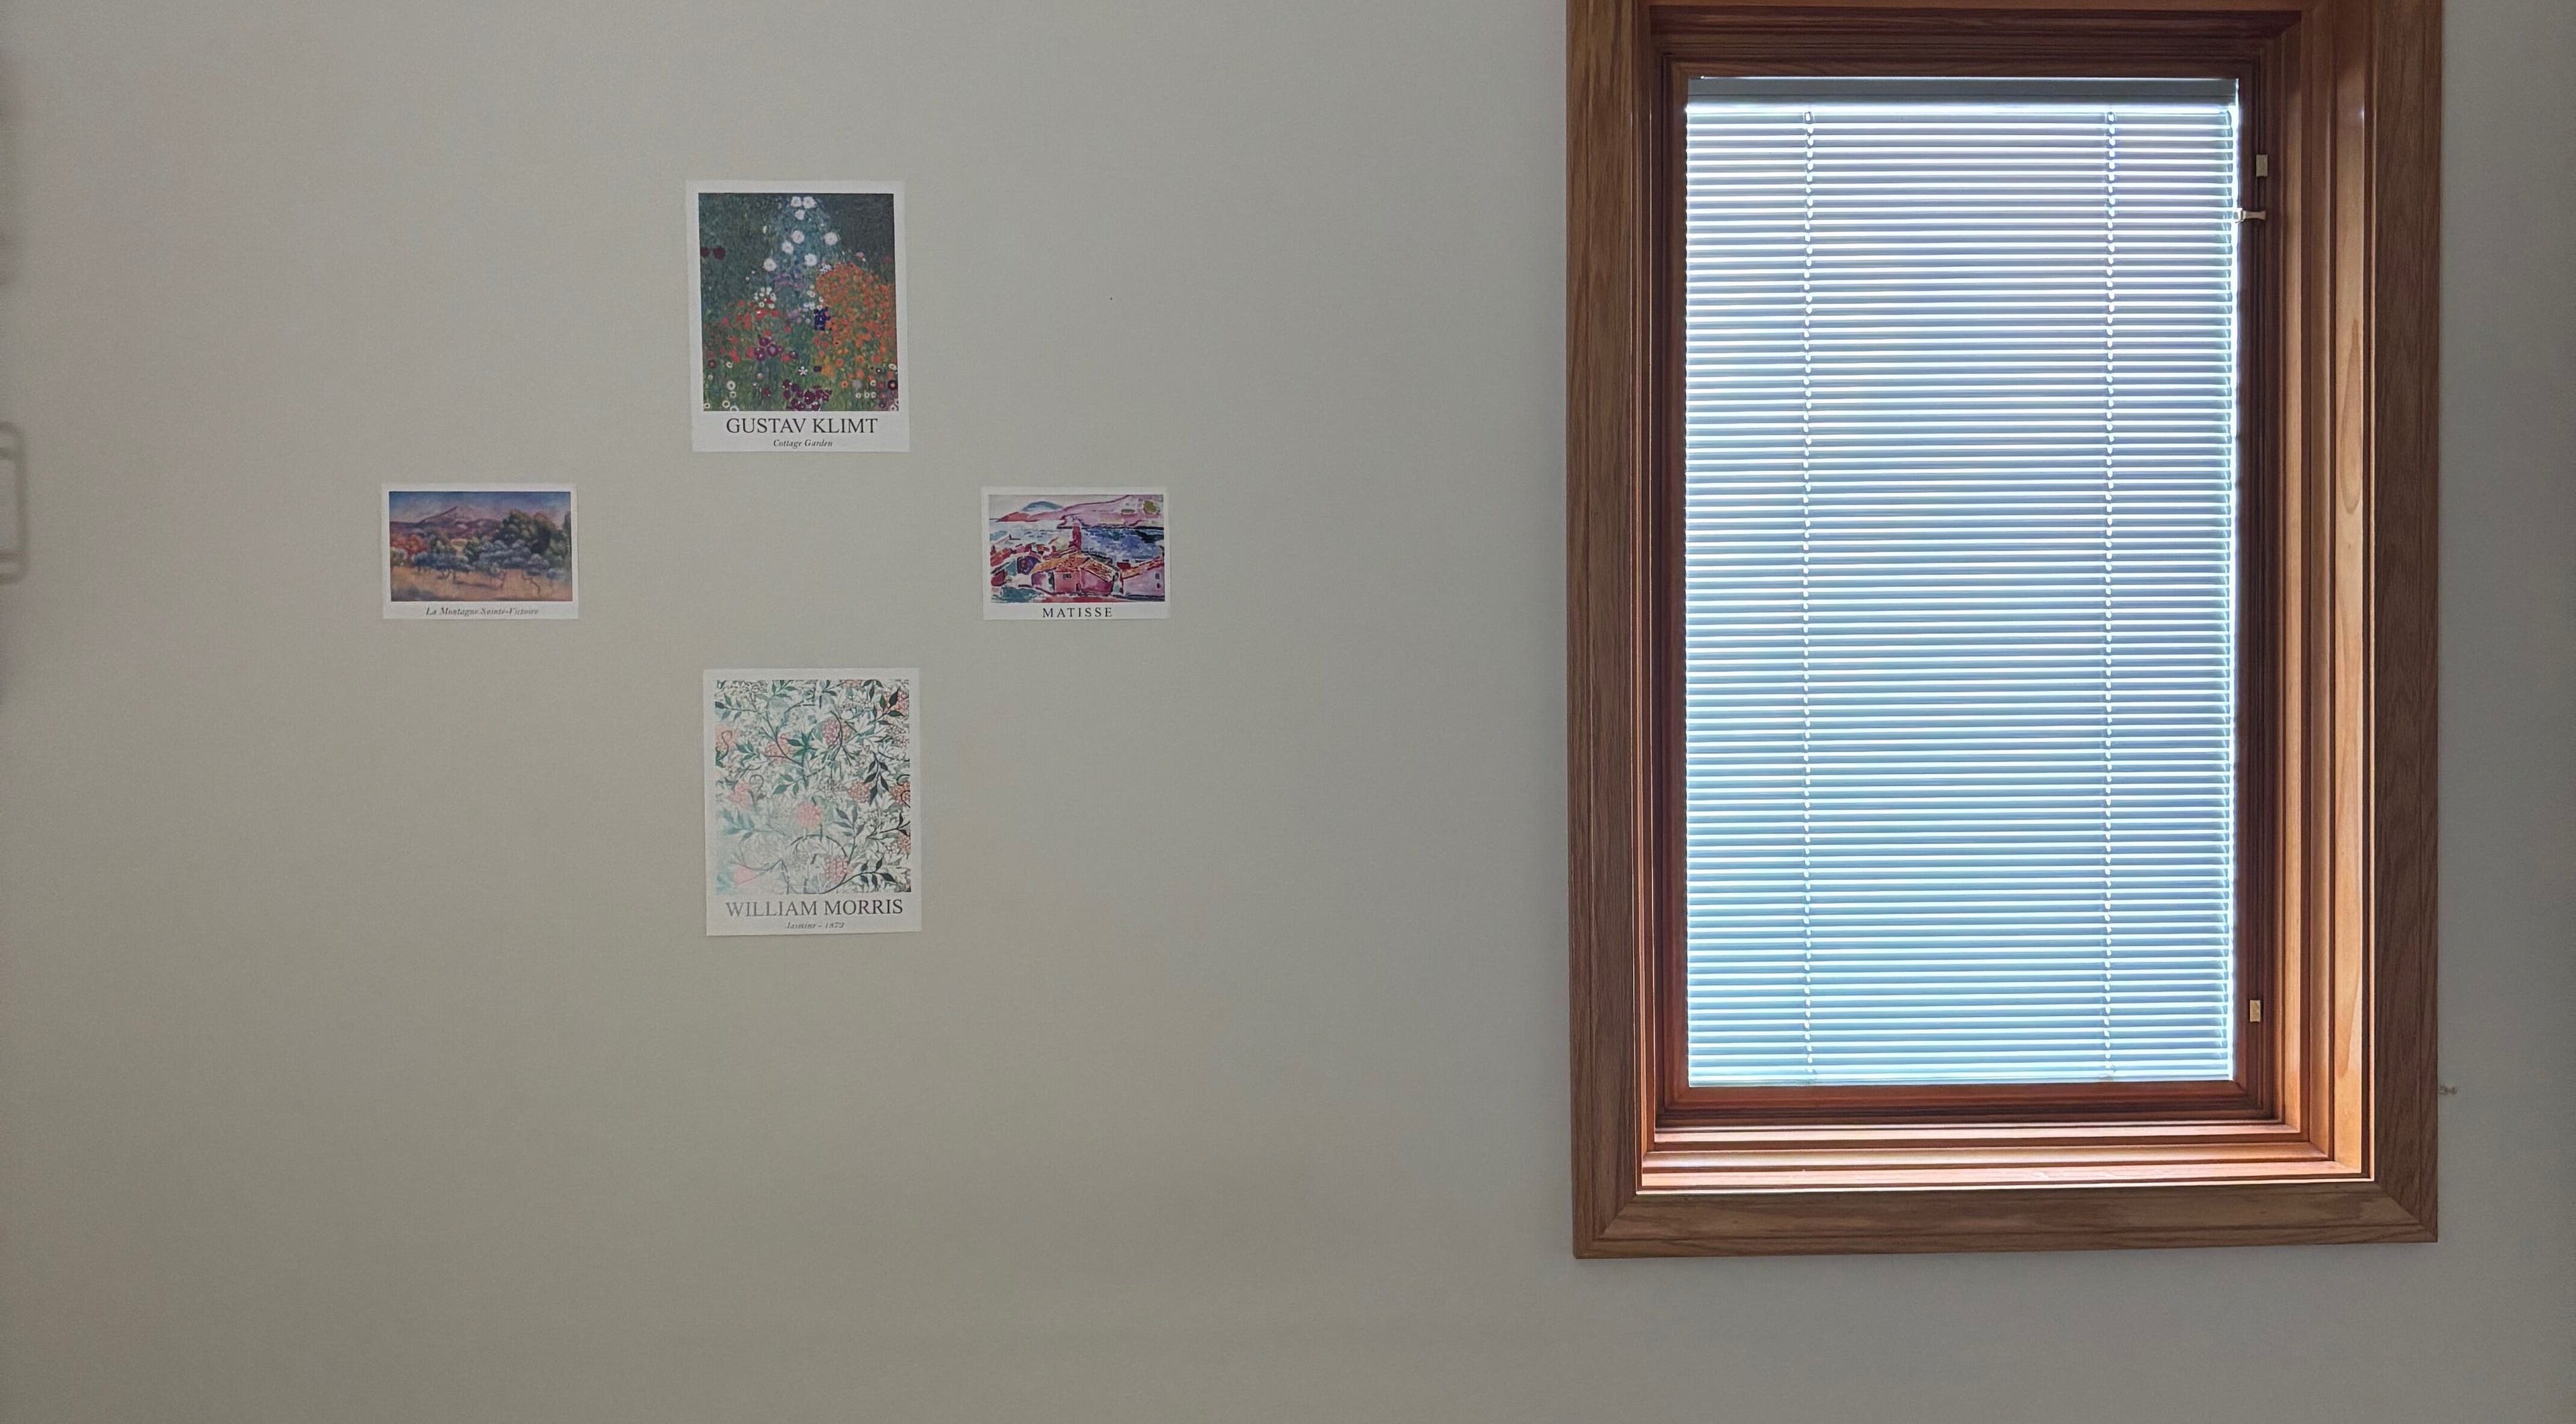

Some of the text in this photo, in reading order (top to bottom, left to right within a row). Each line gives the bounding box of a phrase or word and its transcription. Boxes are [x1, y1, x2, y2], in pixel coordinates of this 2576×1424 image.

[726, 418, 878, 433] GUSTAV KLIMT
[773, 439, 833, 449] Cottage Garden
[425, 607, 437, 616] La
[1042, 607, 1113, 618] MATISSE
[726, 899, 903, 917] WILLIAM MORRIS
